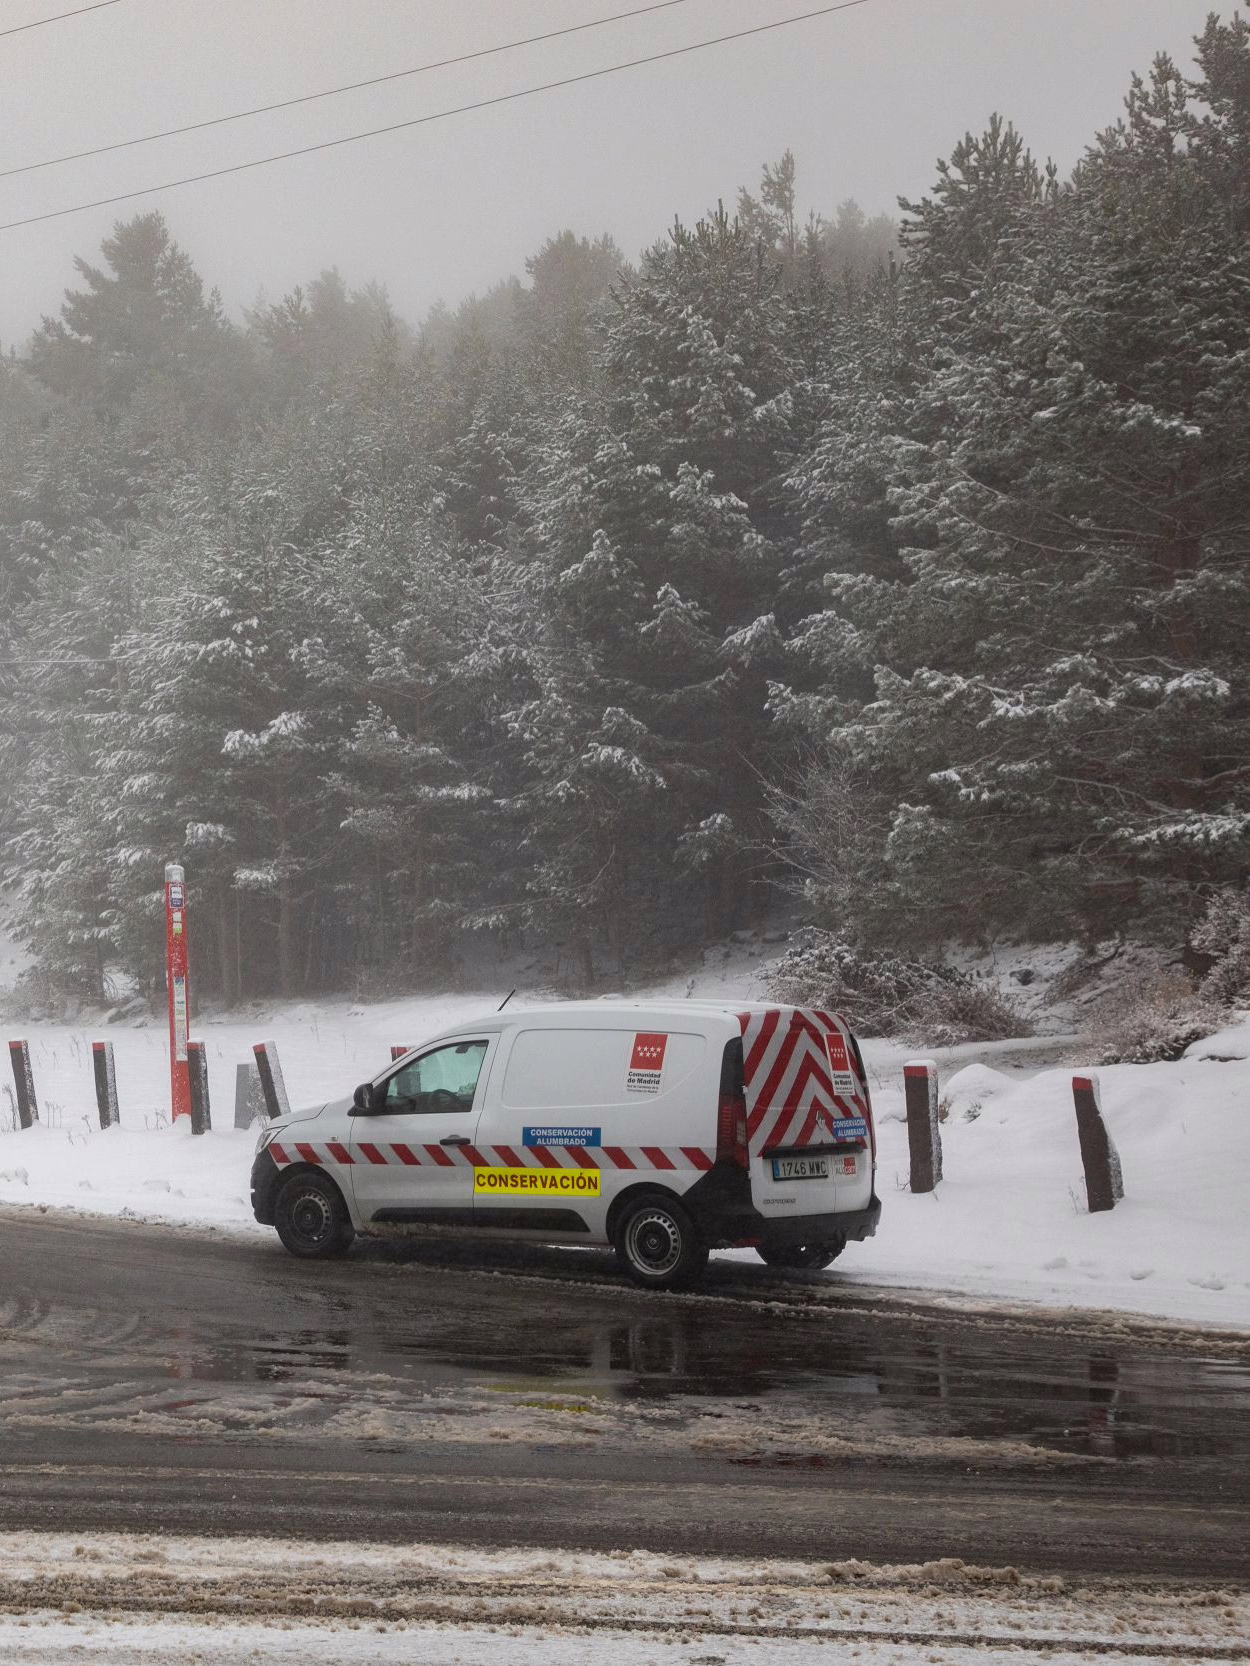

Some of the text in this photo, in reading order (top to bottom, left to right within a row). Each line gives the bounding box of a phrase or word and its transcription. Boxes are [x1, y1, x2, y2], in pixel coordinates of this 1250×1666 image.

[530, 1127, 593, 1137] CONSERVACIÓN
[837, 1127, 864, 1137] ALUMBRADO
[536, 1138, 587, 1146] ALUMBRADO
[782, 1162, 806, 1176] 1746
[476, 1172, 598, 1190] CONSERVACIÓN
